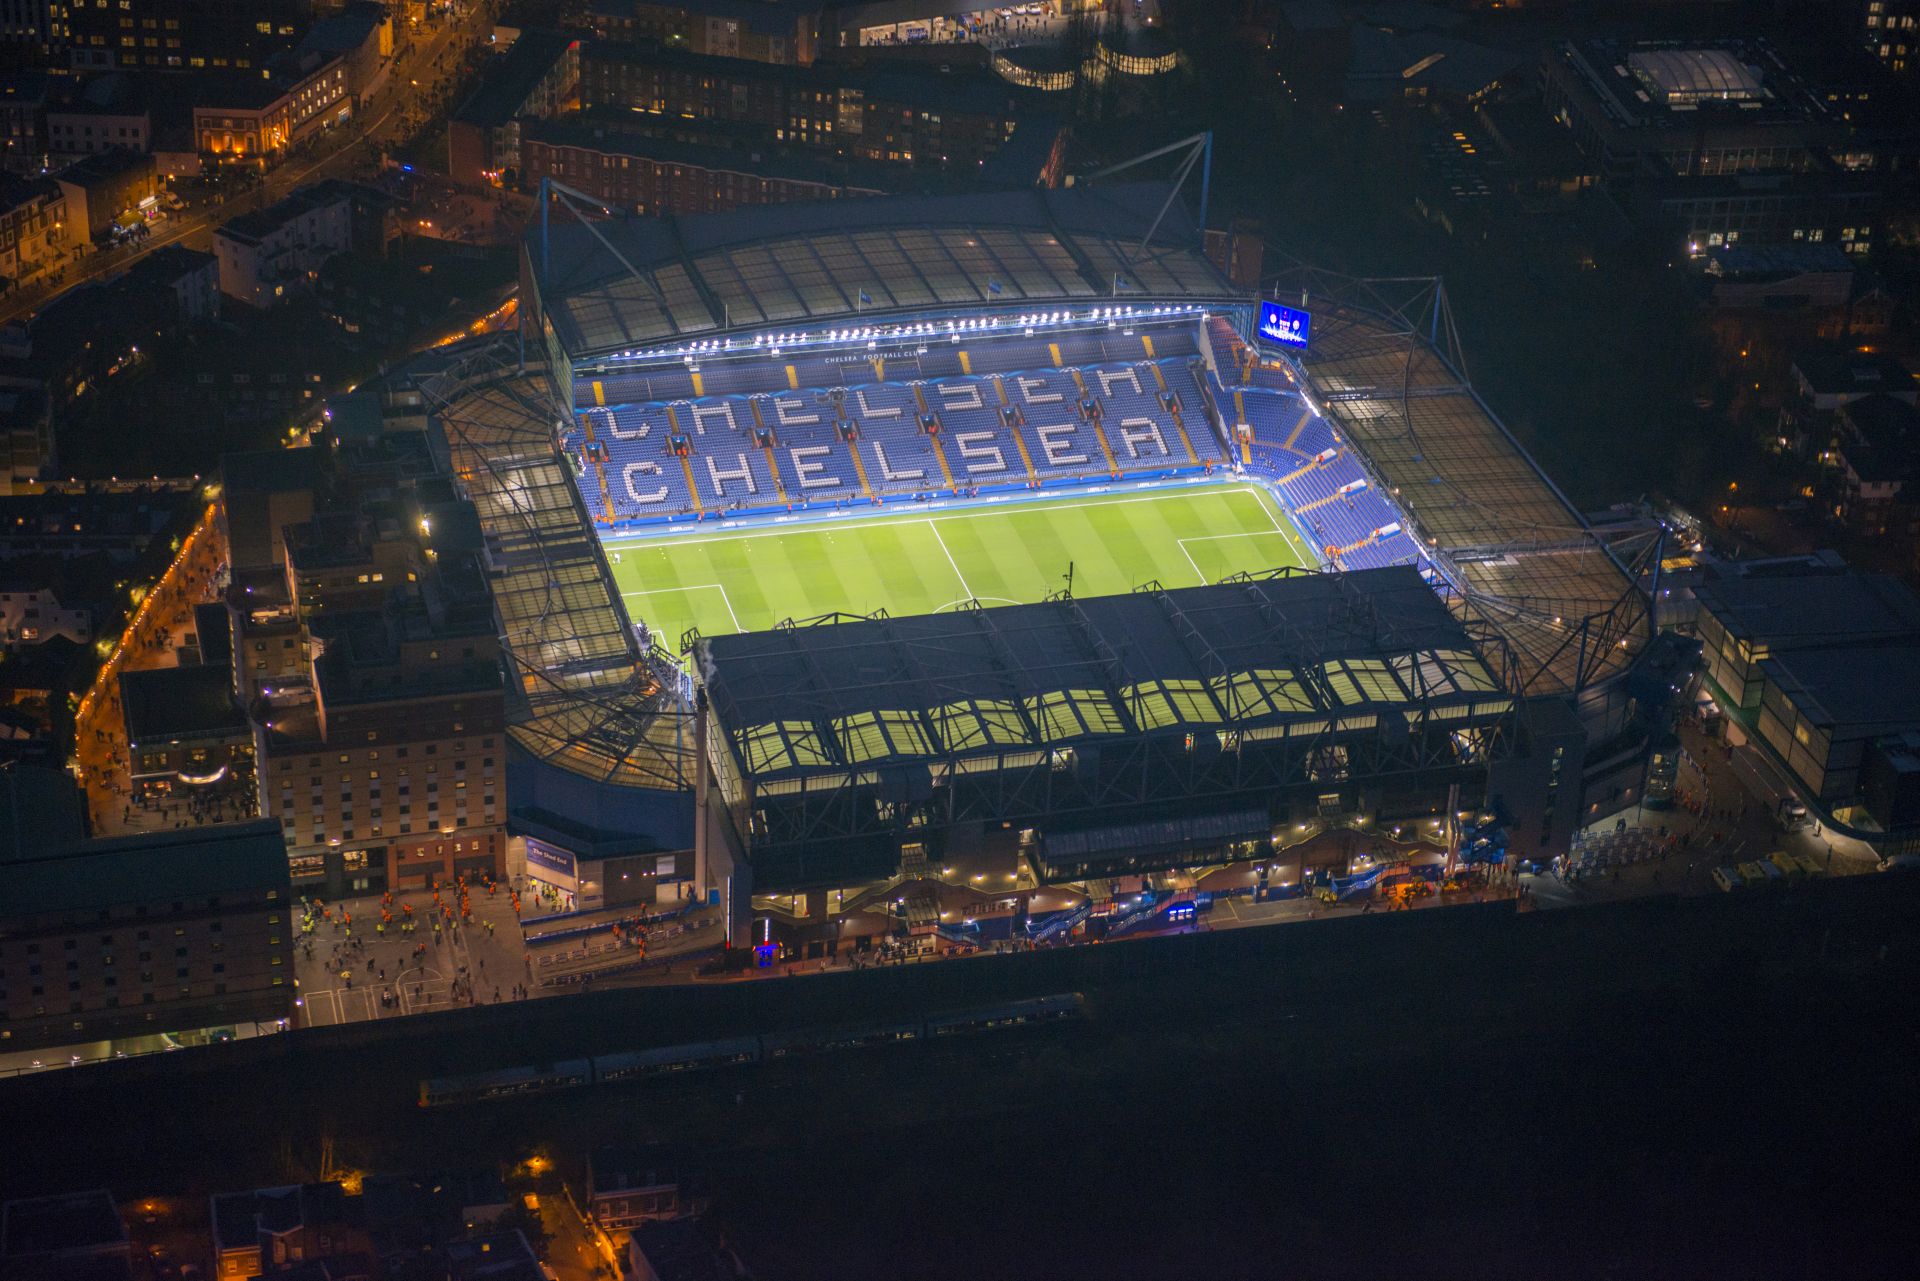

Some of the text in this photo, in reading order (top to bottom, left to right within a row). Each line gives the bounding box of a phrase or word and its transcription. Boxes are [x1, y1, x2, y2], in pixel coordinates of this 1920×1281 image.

[863, 351, 901, 360] FOOTBALL
[622, 417, 1168, 503] CHELSEA
[532, 847, 567, 865] The Shed End
